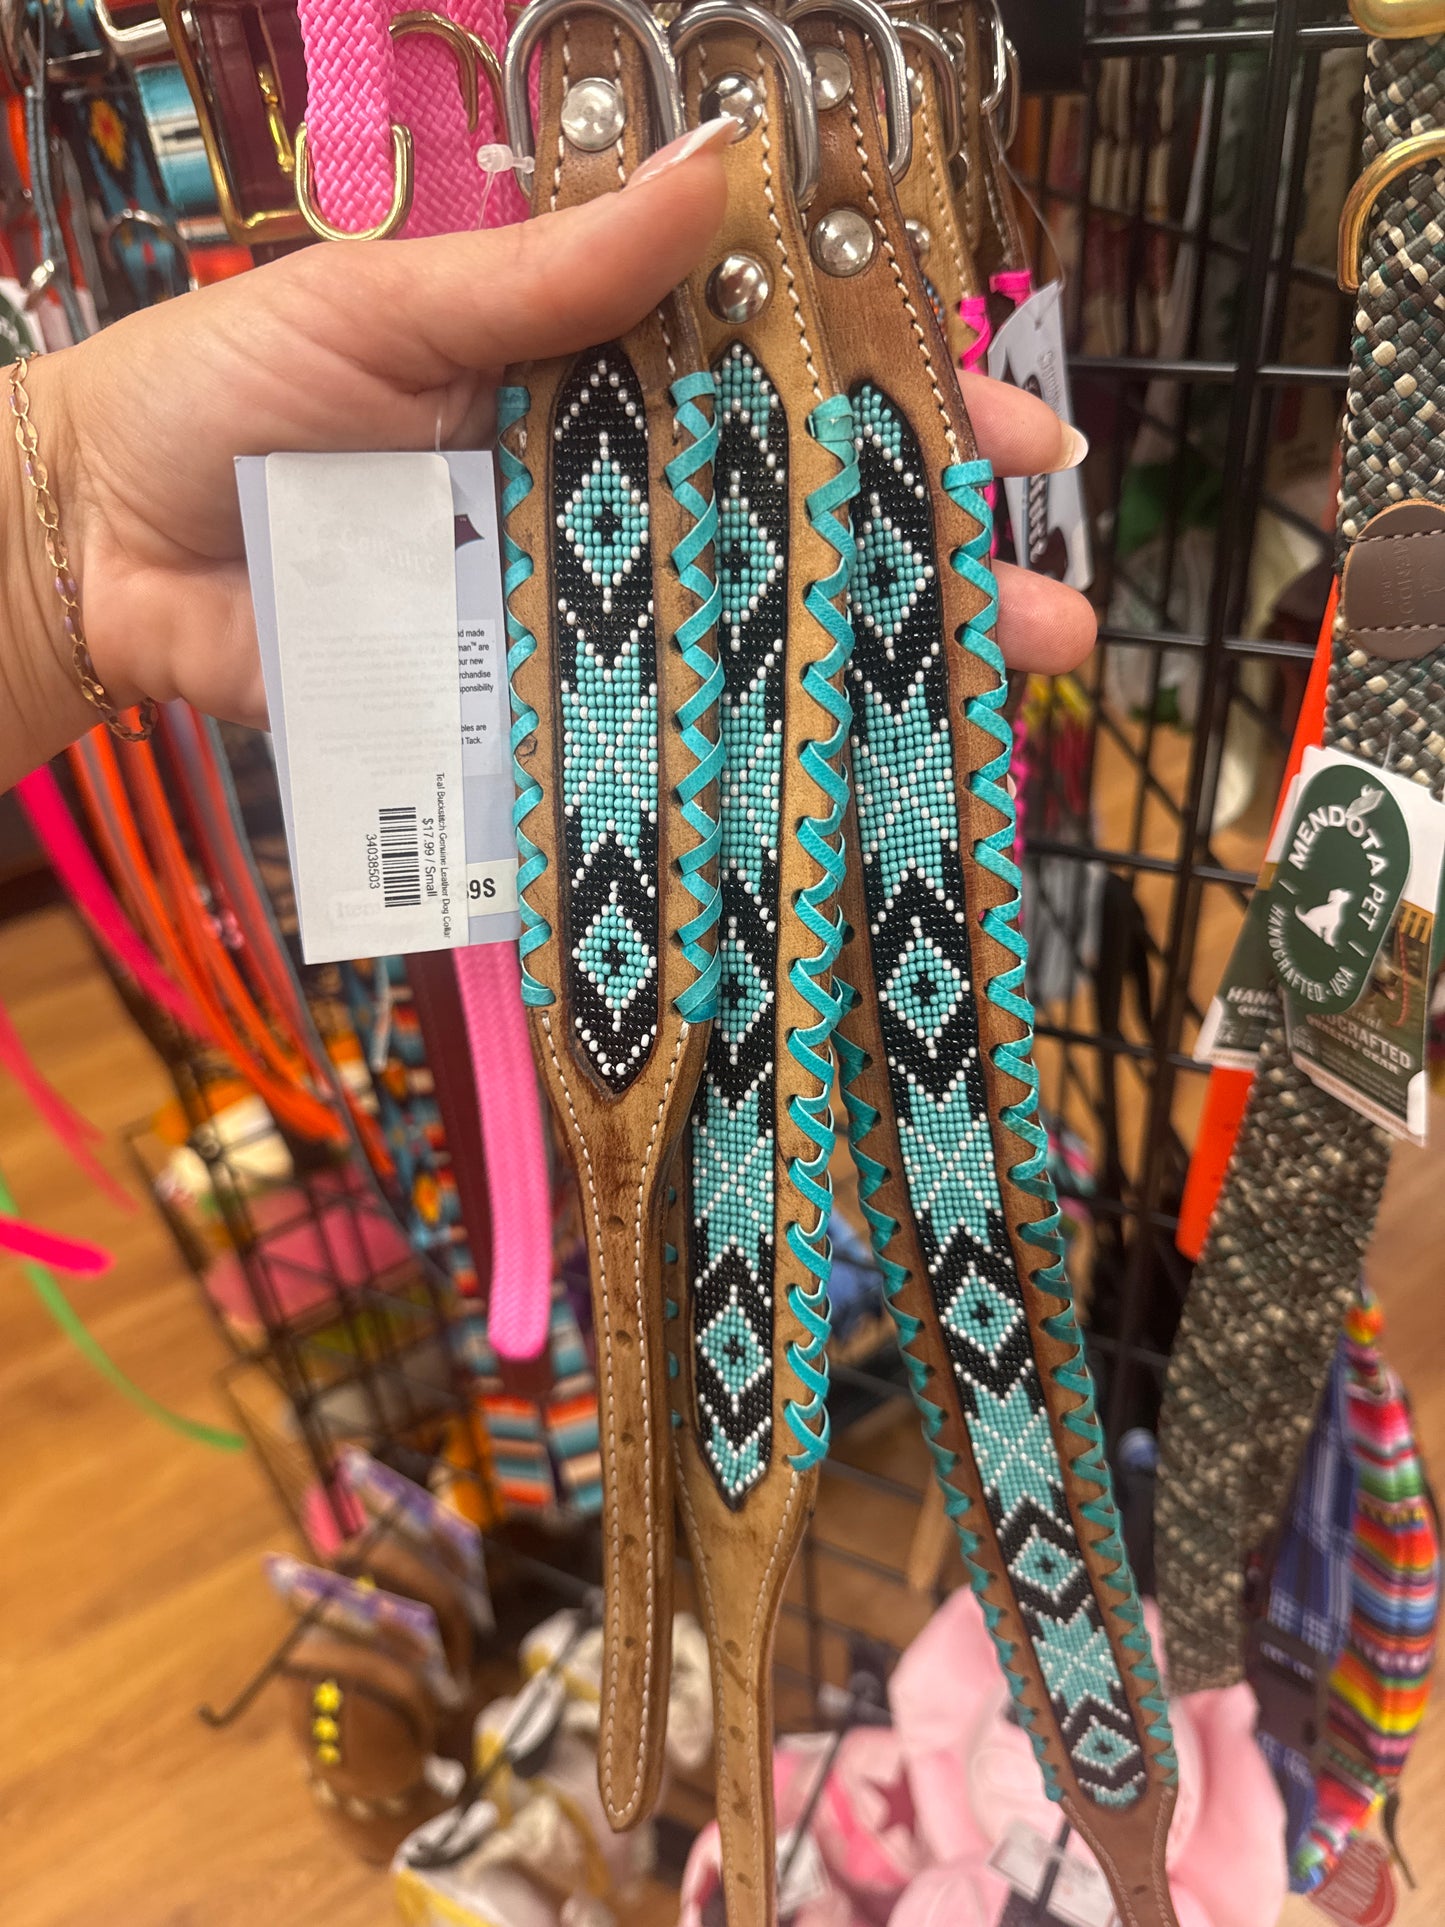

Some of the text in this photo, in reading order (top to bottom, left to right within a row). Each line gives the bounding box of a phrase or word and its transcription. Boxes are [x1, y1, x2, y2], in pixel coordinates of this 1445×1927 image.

[466, 628, 485, 637] made
[422, 817, 435, 856] $17.99
[366, 833, 380, 889] 34038503
[436, 772, 451, 938] Teal Buckstitch Genuine Leather Dog Collar
[1288, 804, 1388, 877] MENDOTA
[1358, 882, 1389, 932] PET
[425, 866, 438, 897] Small
[467, 877, 497, 900] 9S
[1329, 965, 1359, 998] USA
